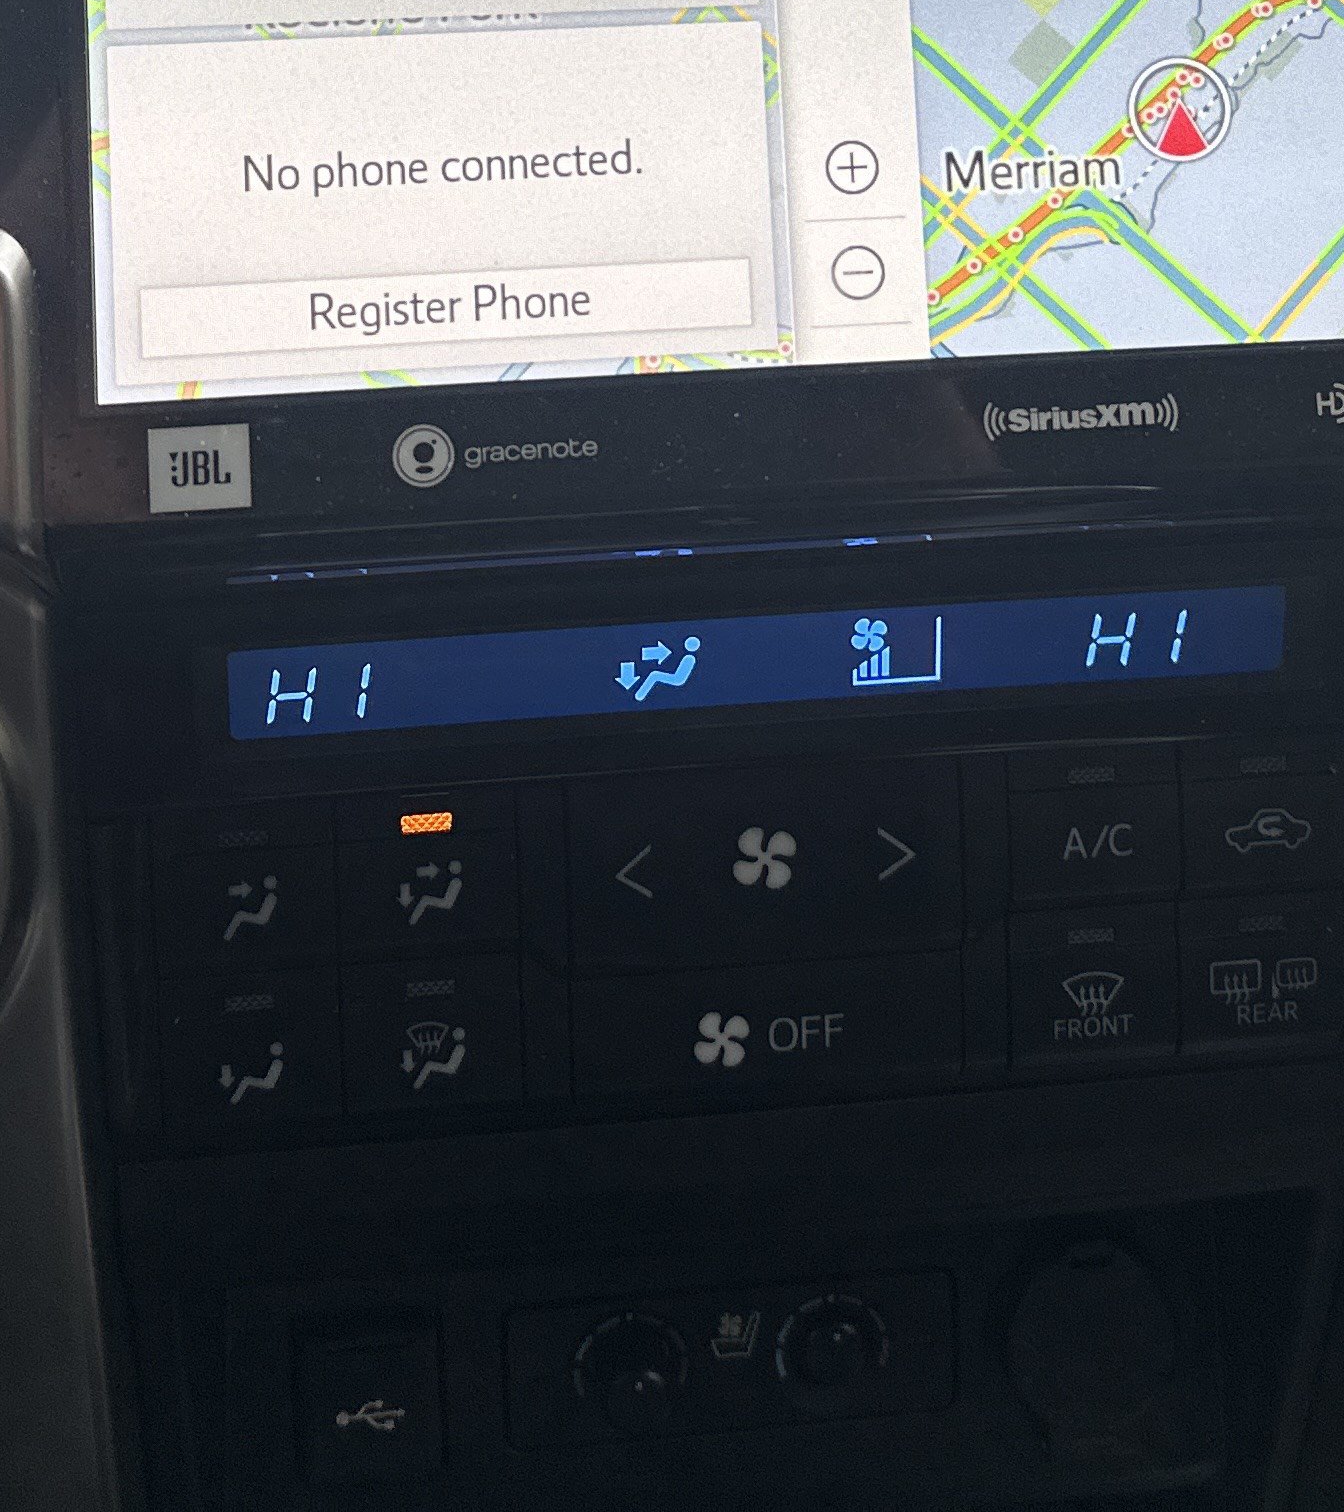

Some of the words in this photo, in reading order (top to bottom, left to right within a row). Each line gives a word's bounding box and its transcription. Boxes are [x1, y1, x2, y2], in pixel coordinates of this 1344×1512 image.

[243, 156, 300, 192] No
[312, 152, 428, 196] phone
[441, 139, 643, 185] connected.
[945, 149, 1121, 192] Merriam
[309, 292, 462, 335] Register
[474, 285, 591, 322] Phone
[169, 450, 232, 486] JBL
[464, 438, 598, 469] gracenote
[1062, 823, 1133, 860] A/C
[1054, 1014, 1133, 1040] FRONT
[1236, 1001, 1299, 1025] REAR
[768, 1014, 844, 1051] OFF
